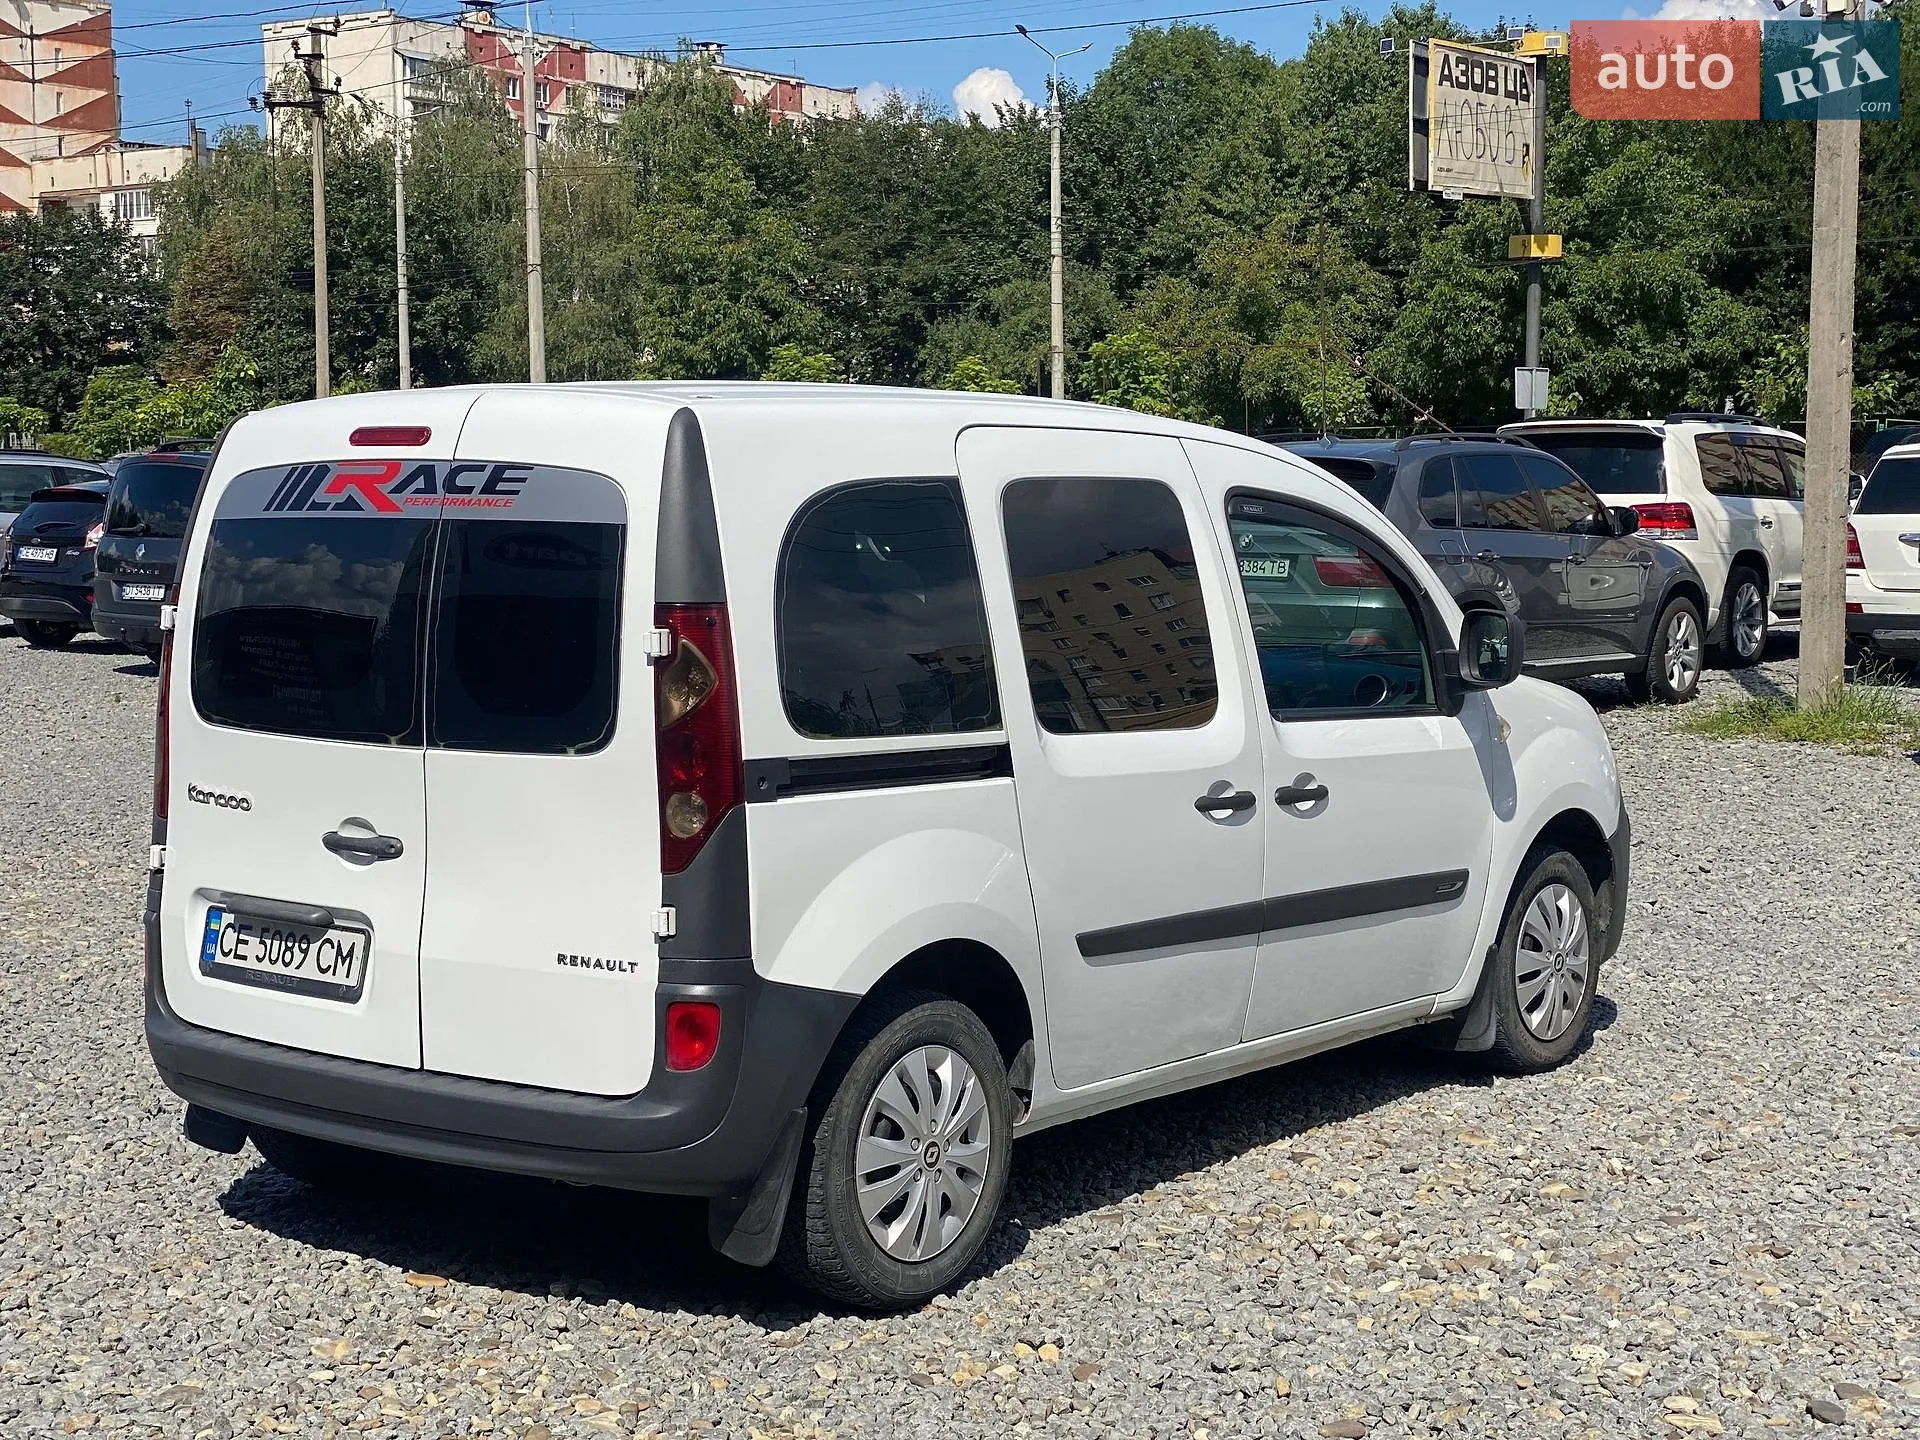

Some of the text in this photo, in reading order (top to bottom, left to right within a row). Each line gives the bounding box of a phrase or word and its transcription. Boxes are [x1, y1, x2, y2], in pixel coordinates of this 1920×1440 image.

[1438, 54, 1498, 96] АЗОВ
[324, 461, 535, 513] RACE
[402, 496, 516, 509] PERFORMANCE
[119, 567, 160, 575] ESPACE
[206, 942, 216, 954] UA
[219, 922, 356, 979] CE 5089 CM
[557, 953, 638, 974] RENAULT
[245, 969, 301, 987] RENAULT
